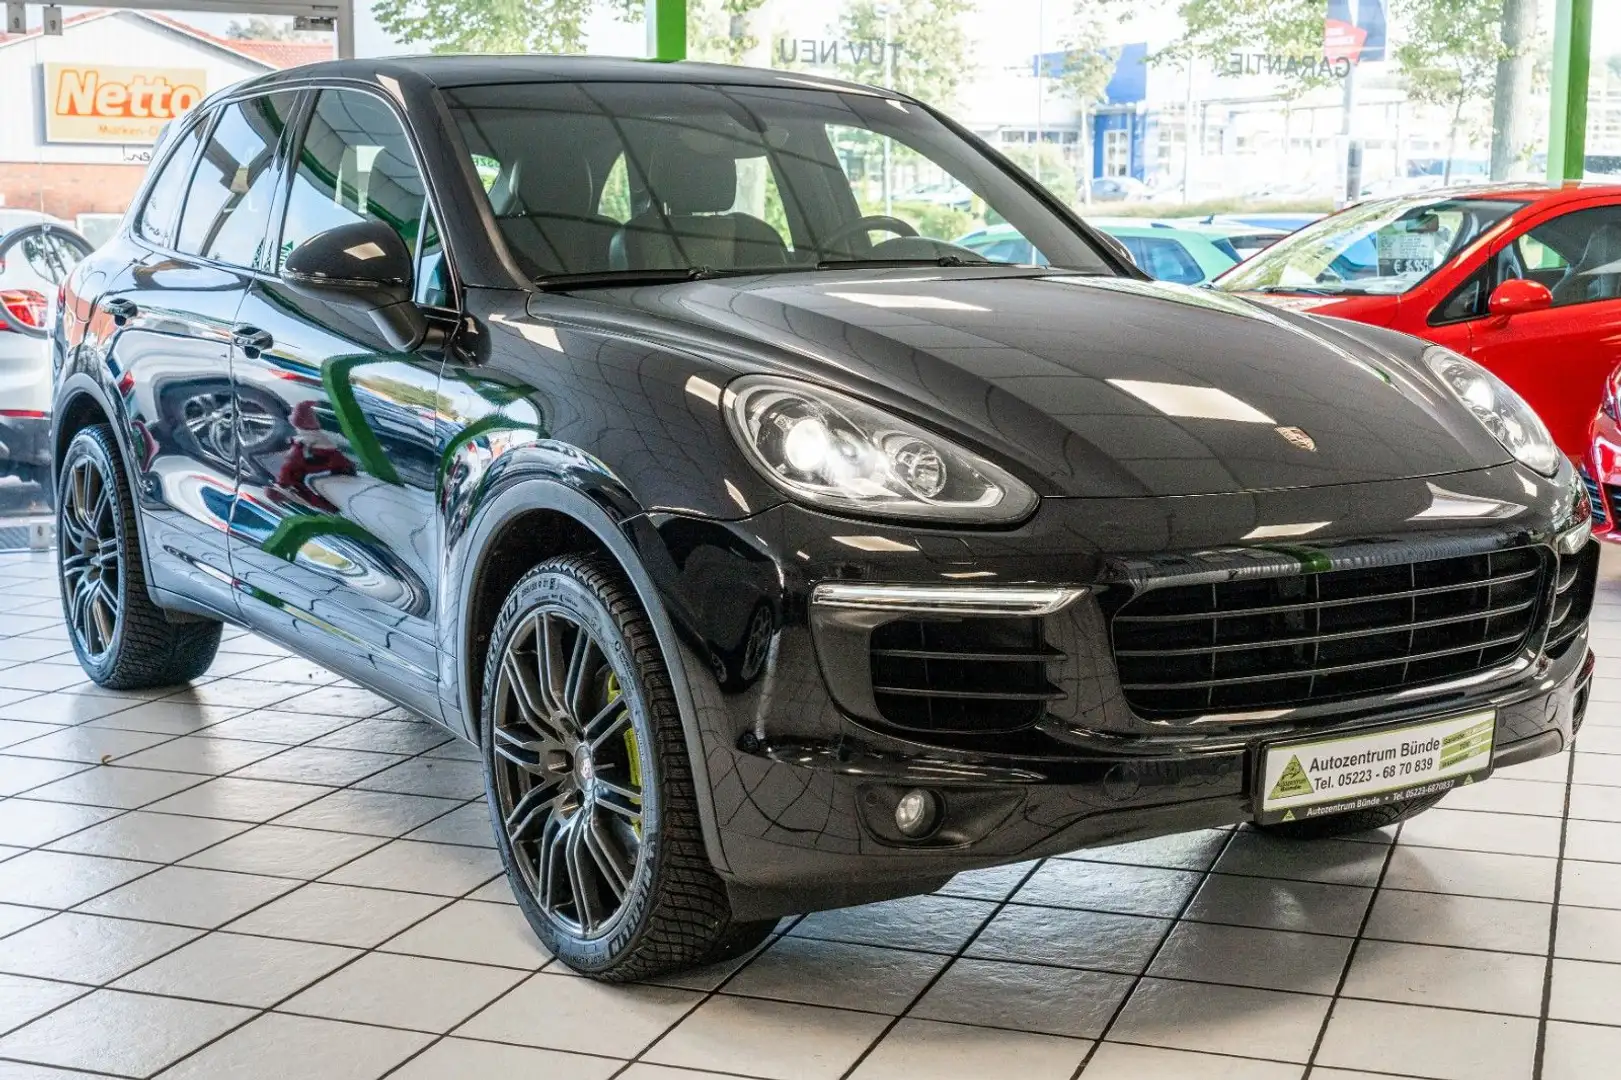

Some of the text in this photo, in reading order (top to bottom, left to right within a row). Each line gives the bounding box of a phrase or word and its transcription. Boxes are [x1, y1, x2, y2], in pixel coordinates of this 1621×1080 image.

[56, 69, 202, 119] Netto
[1309, 738, 1440, 773] Autozentrum Bünde
[1314, 776, 1334, 791] Tel.
[1338, 769, 1372, 787] 05223
[1382, 765, 1396, 779] 68
[1399, 761, 1412, 776] 70
[1414, 757, 1433, 773] 839
[1306, 800, 1355, 817] Autozentrum
[1357, 797, 1381, 808] Bünde
